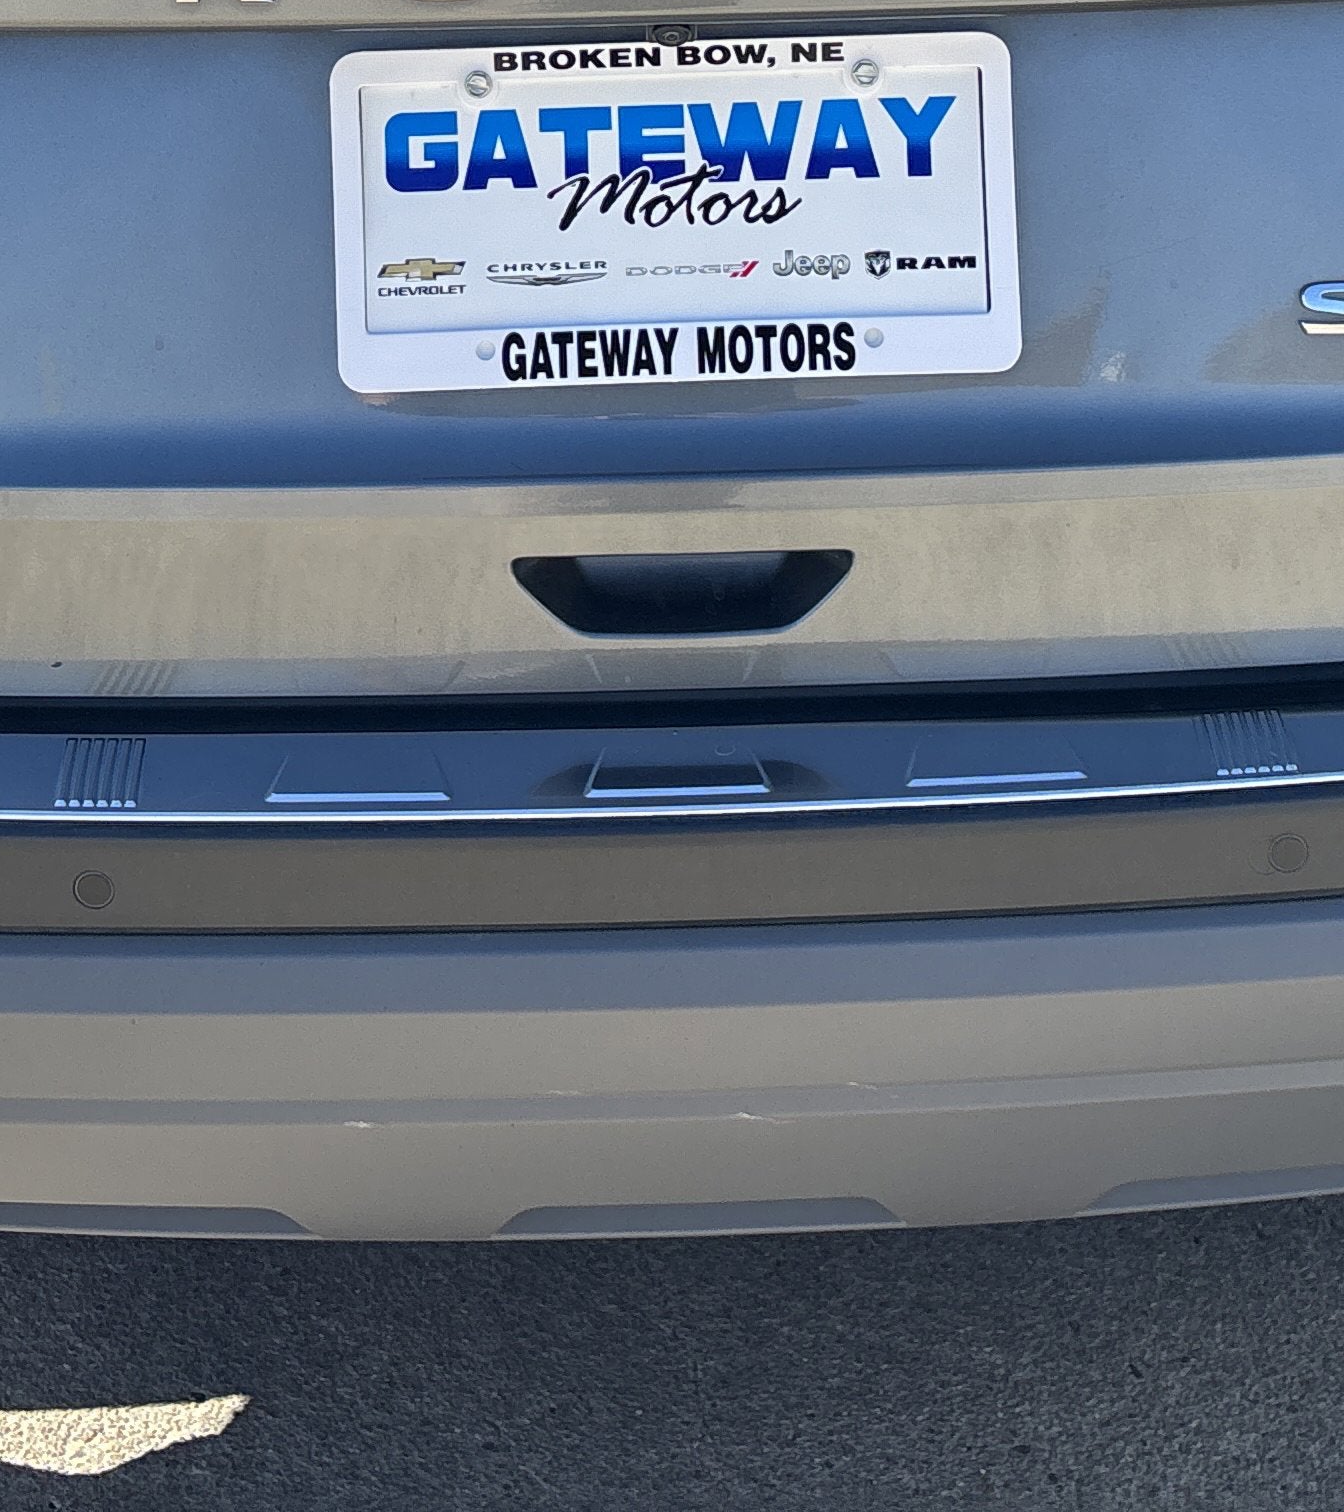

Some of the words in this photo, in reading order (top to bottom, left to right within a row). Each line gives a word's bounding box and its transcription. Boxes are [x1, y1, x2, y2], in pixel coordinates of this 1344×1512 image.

[493, 47, 661, 72] BROKEN
[677, 44, 776, 68] BOW,
[790, 41, 845, 63] NE
[384, 96, 957, 193] GATEWAY
[548, 164, 803, 232] Motors
[486, 260, 607, 273] CHRYSLER
[625, 263, 746, 277] DODGE
[772, 250, 851, 279] Jeep
[896, 255, 977, 270] RAM
[377, 284, 466, 297] CHEVROLET
[501, 327, 679, 381] GATEWAY
[697, 323, 856, 374] MOTORS
